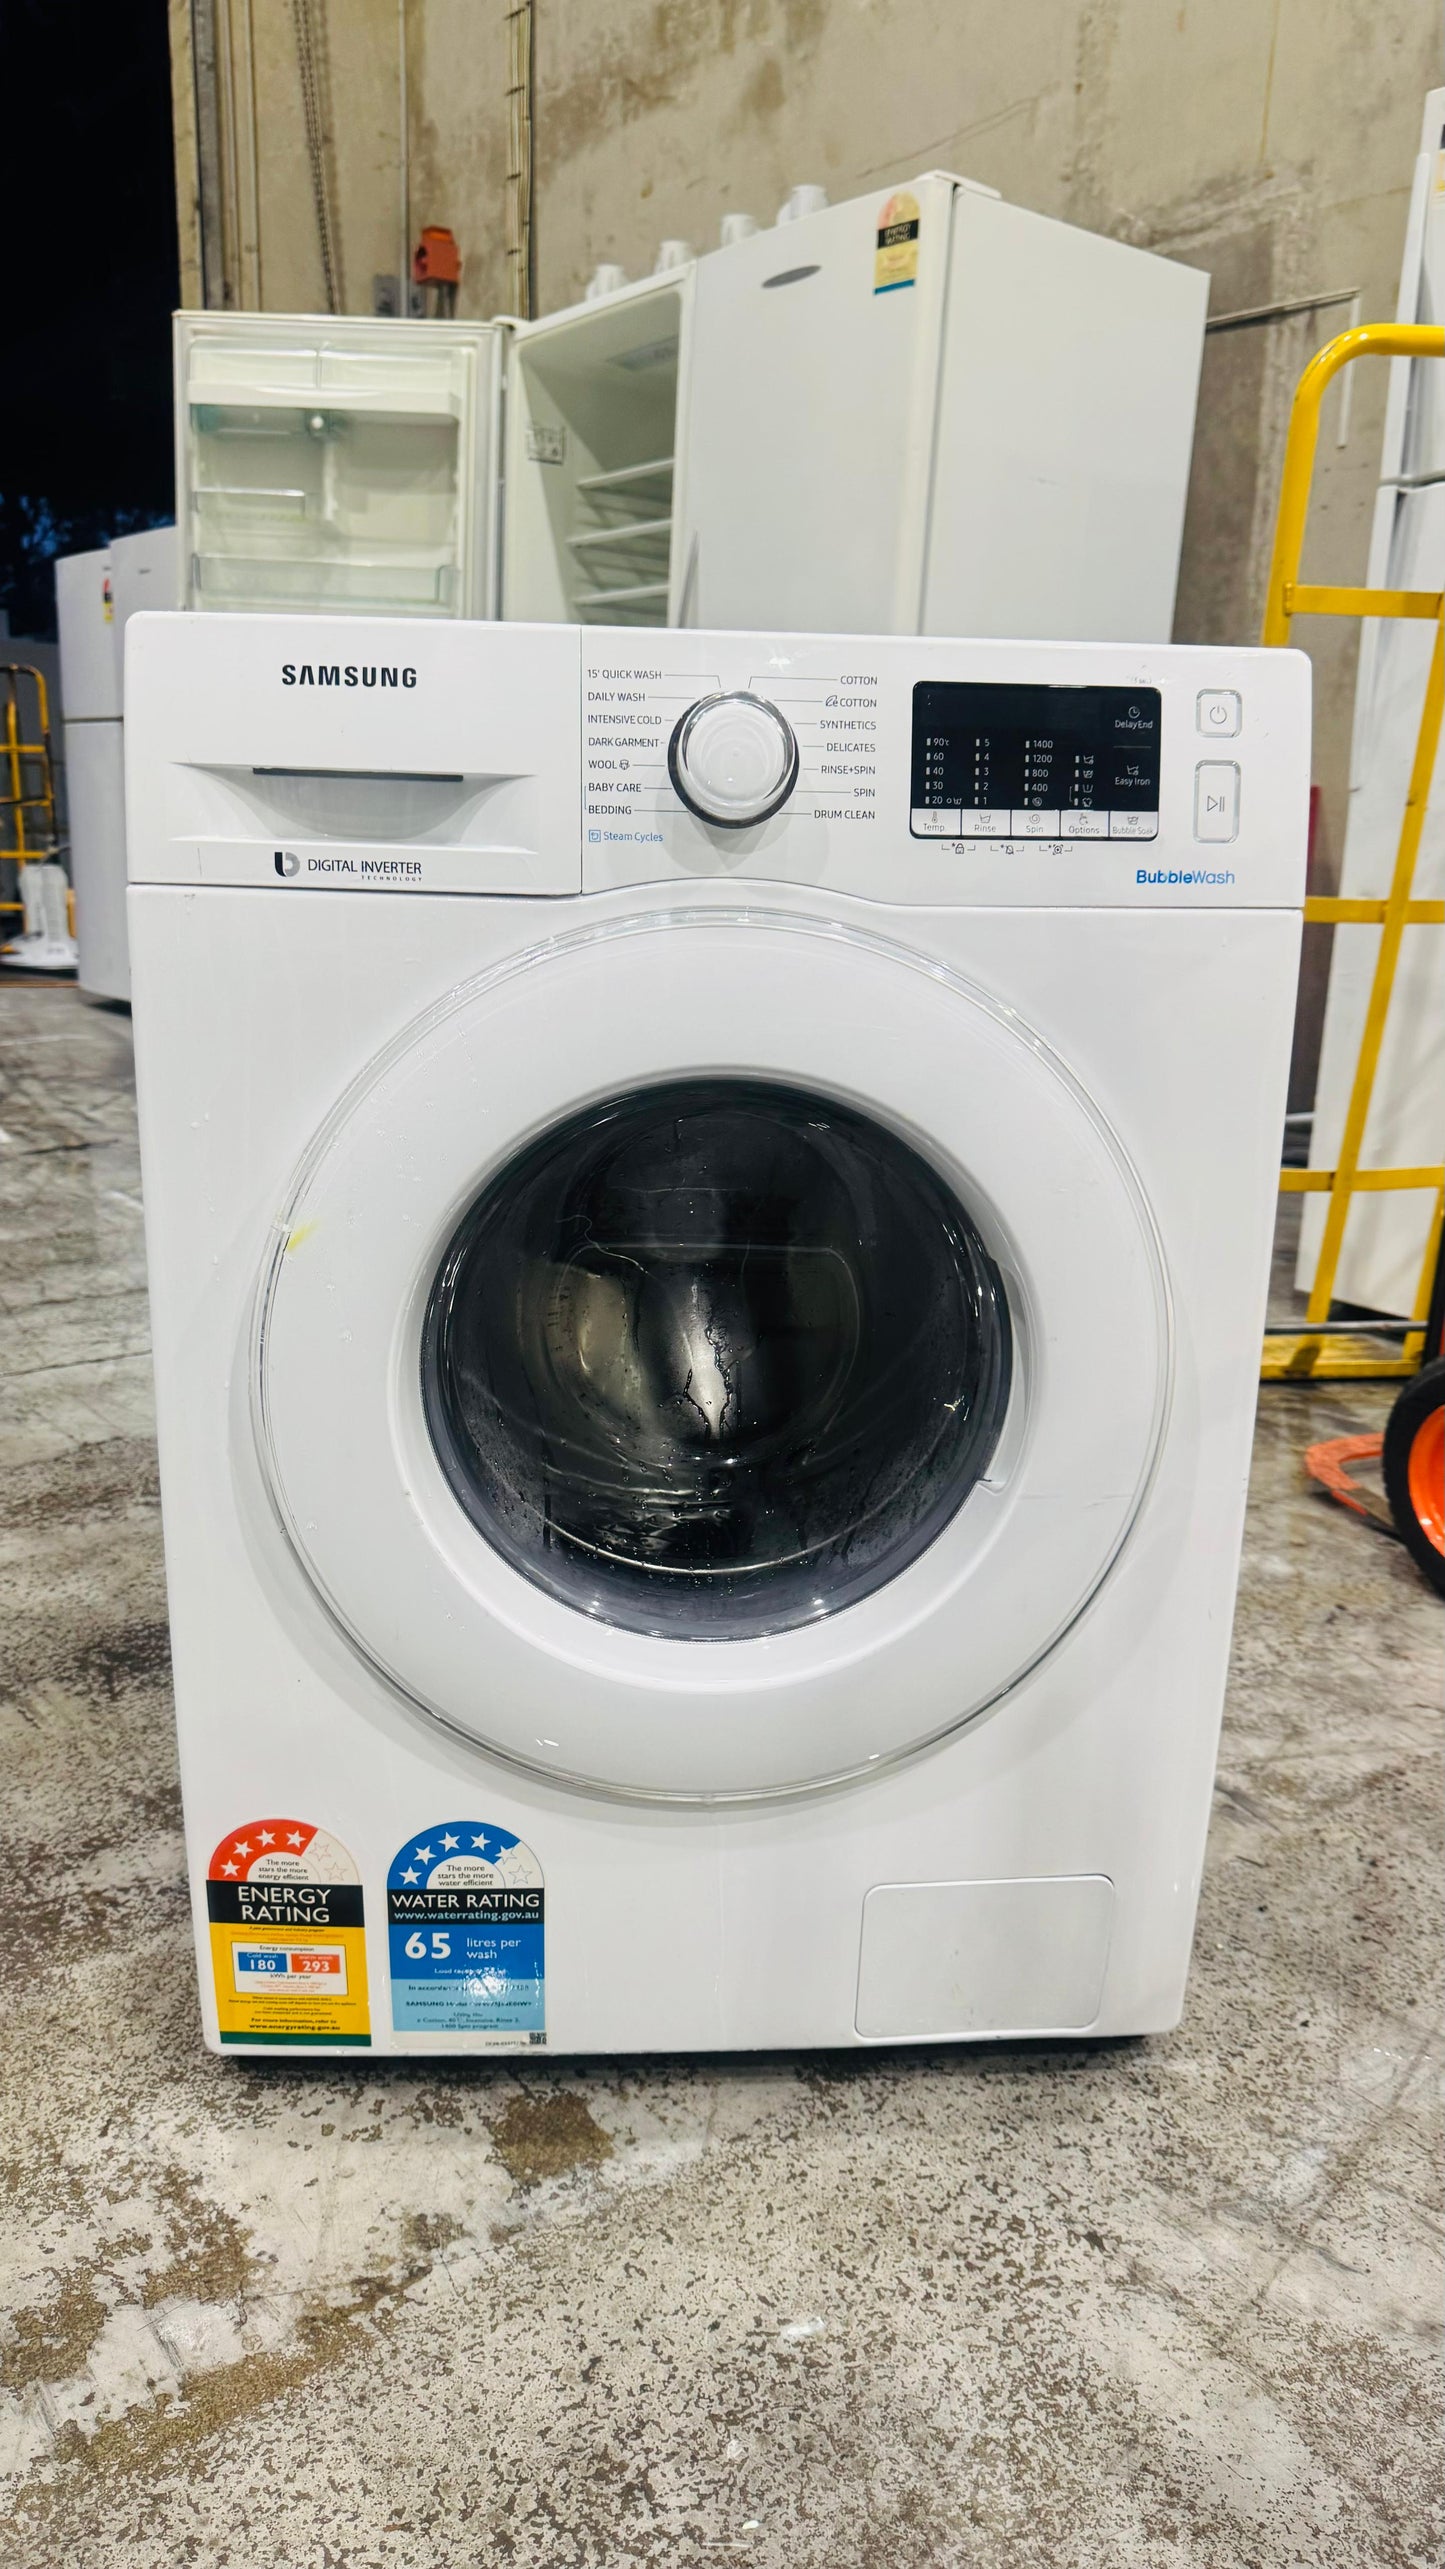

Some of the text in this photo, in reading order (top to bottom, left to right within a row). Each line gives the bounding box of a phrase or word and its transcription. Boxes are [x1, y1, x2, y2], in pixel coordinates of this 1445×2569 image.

[282, 664, 417, 688] SAMSUNG
[587, 669, 662, 679] 15' QUICK WASH
[840, 676, 877, 685] COTTON
[588, 692, 645, 701] DAILY WASH
[840, 698, 877, 707] COTTON
[588, 714, 662, 724] INTENSIVE COLD
[820, 720, 877, 730] SYNTHETICS
[588, 737, 659, 747] DARK GARMENT
[1033, 740, 1053, 748] 1400
[826, 743, 876, 752] DELICATES
[984, 753, 989, 761] 4
[1033, 755, 1052, 763] 1200
[588, 760, 617, 769] WOOL
[821, 765, 876, 774] RINSE+SPIN
[933, 767, 944, 775] 40
[1032, 769, 1048, 777] 800
[933, 782, 943, 790] 30
[983, 782, 988, 790] 2
[1115, 777, 1151, 787] Easy Iron
[588, 783, 642, 792] BABY CARE
[1031, 784, 1048, 792] 400
[854, 788, 875, 797] SPIN
[932, 796, 943, 804] 20
[588, 805, 631, 815] BEDDING
[814, 809, 875, 819] DRUM CLEAN
[923, 824, 944, 832] Temp
[974, 824, 996, 832] Rinse
[1026, 825, 1044, 833] Spin
[1069, 826, 1100, 835] Options
[1112, 827, 1135, 835] Bubble
[603, 831, 664, 843] Steam Cycles
[308, 859, 422, 874] DIGITAL INVERTER
[1136, 870, 1235, 884] BubbleWash
[238, 1886, 331, 1905] ENERGY
[391, 1894, 540, 1908] WATER RATING
[241, 1905, 330, 1923] RATING
[394, 1910, 539, 1921] www.waterrating.gov.au
[405, 1932, 451, 1959] 65
[466, 1937, 521, 1950] litres per
[466, 1949, 497, 1959] wash
[250, 1959, 276, 1971] 180
[302, 1961, 330, 1972] 293
